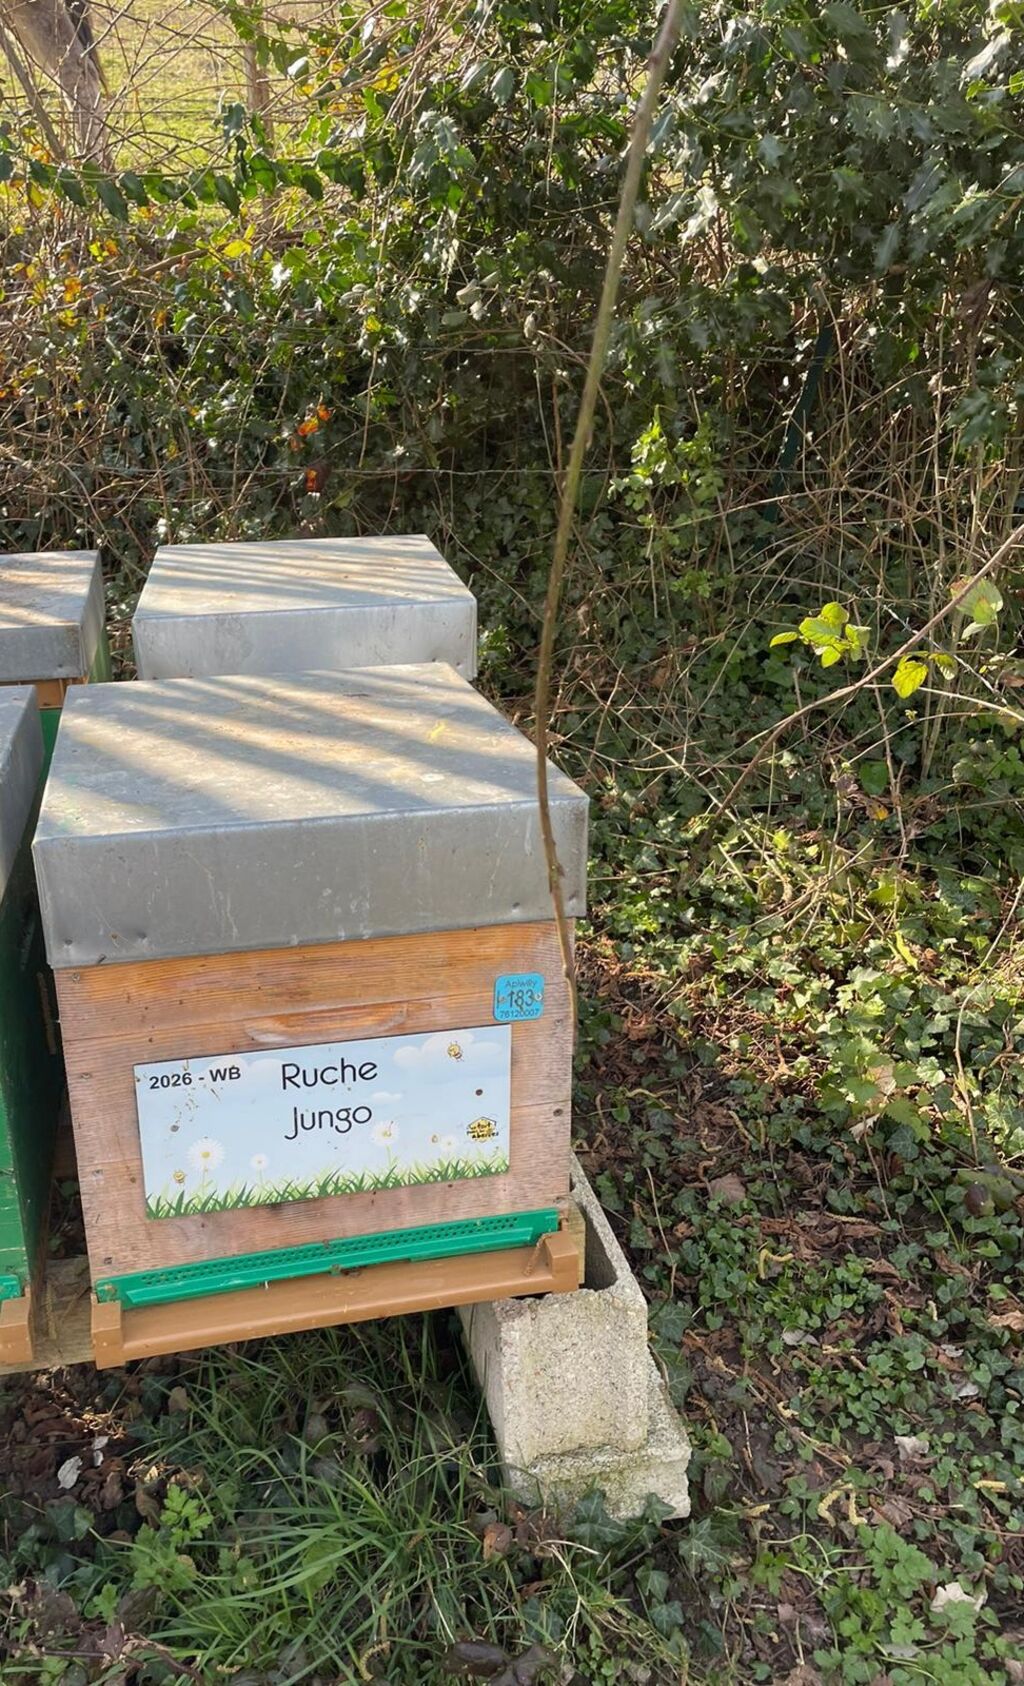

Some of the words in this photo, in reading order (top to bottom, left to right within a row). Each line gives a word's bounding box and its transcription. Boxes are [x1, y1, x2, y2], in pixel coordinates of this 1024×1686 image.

[508, 988, 534, 1008] 183
[149, 1072, 193, 1090] 2026
[209, 1066, 241, 1082] WB
[281, 1057, 378, 1090] Ruche
[284, 1106, 373, 1140] Jungo
